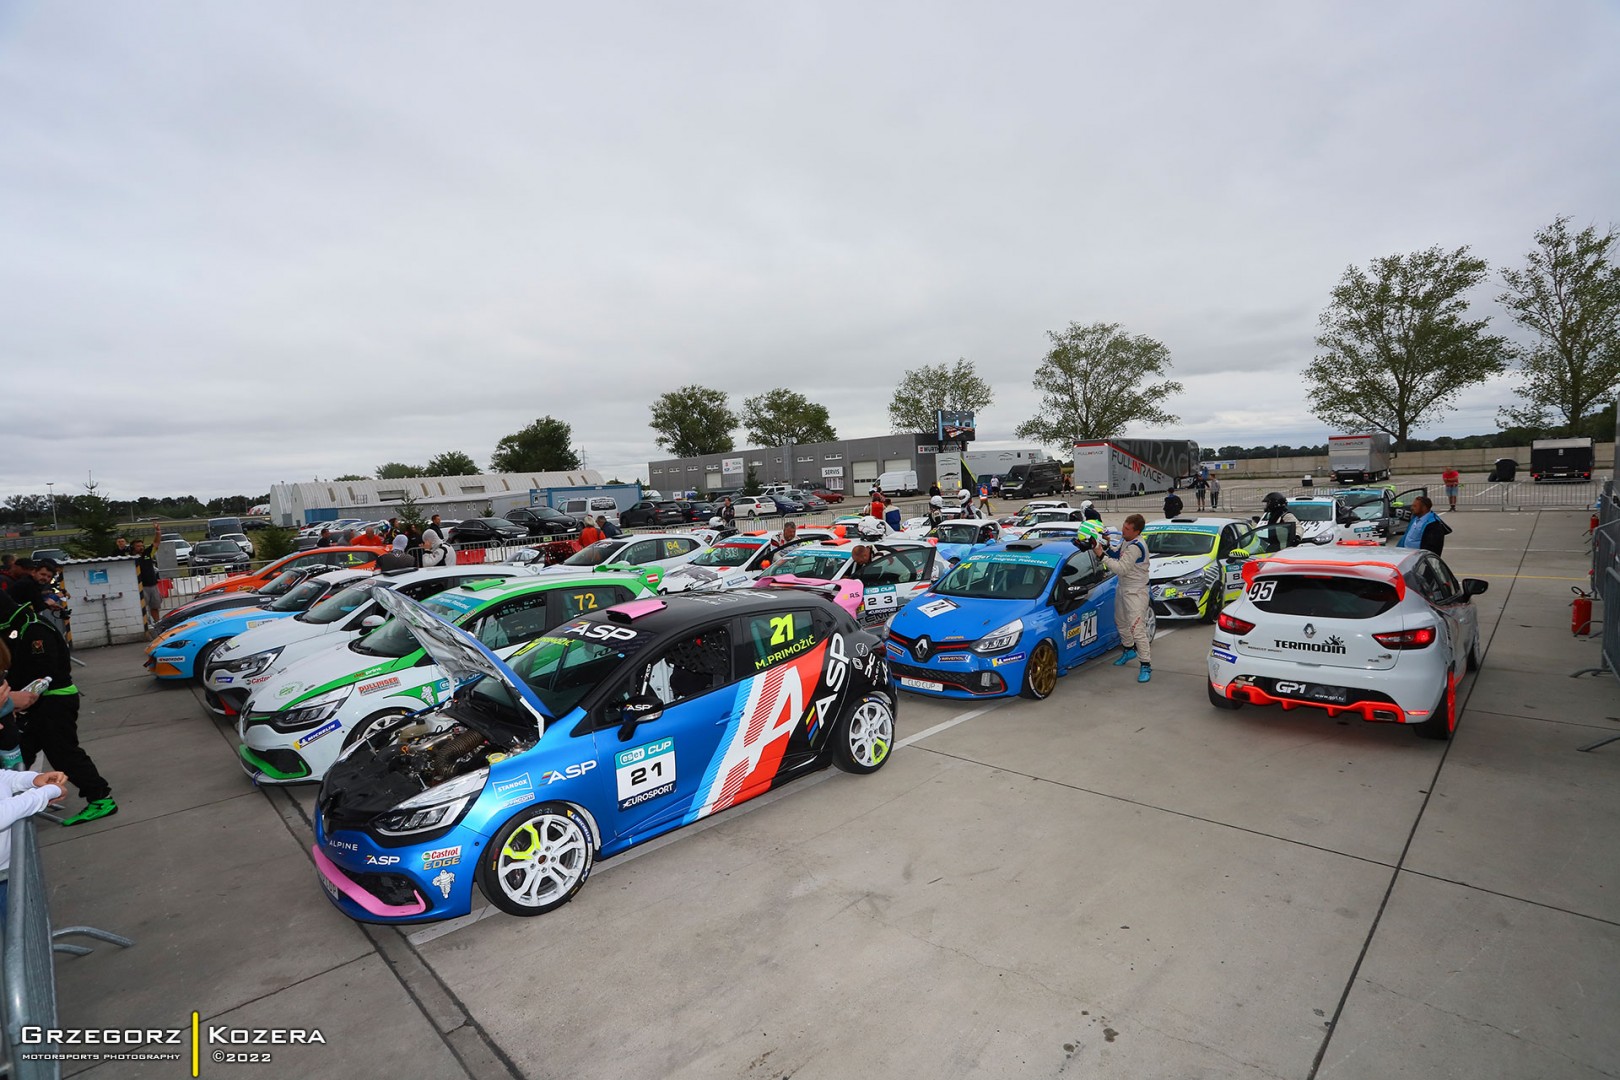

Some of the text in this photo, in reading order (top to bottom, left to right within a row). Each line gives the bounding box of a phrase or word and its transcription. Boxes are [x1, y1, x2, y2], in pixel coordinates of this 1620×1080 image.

[1112, 450, 1161, 483] FULLINRACE
[667, 541, 680, 550] 64
[1249, 582, 1275, 601] 95
[574, 593, 598, 611] 72
[564, 622, 638, 641] ASP
[770, 613, 795, 646] 21
[1083, 618, 1092, 639] 74
[755, 634, 816, 670] M.PRIMOŽIČ
[1274, 639, 1346, 654] TERMODIN
[816, 632, 850, 729] ASP
[1276, 681, 1307, 694] GP1
[308, 723, 336, 742] MICHELIN
[647, 740, 672, 755] CUP
[548, 759, 597, 785] ASP
[630, 762, 663, 787] 21
[498, 779, 527, 793] STANDOX
[623, 784, 673, 808] EUROSPORT
[575, 816, 591, 843] MICHELIN
[329, 840, 358, 851] ALPINE
[431, 848, 459, 859] Castrol
[366, 855, 400, 866] ASP
[423, 856, 461, 870] EDGE
